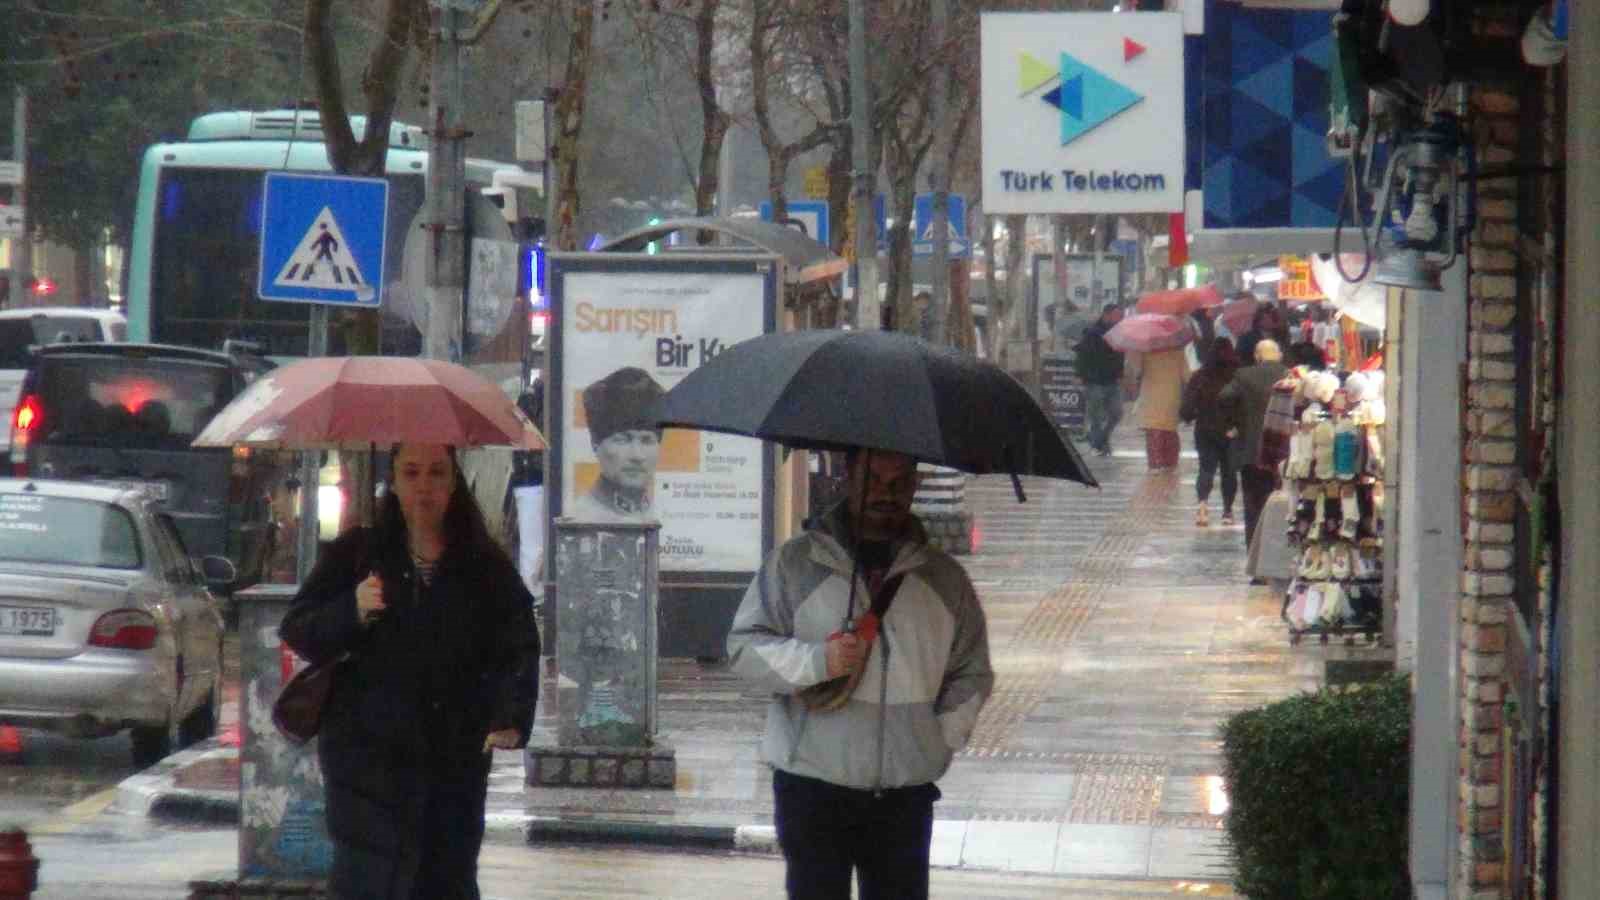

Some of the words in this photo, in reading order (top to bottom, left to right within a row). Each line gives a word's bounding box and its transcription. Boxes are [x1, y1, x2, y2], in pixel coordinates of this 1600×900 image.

[1000, 170, 1054, 192] Türk
[1062, 170, 1166, 192] Telekom
[575, 302, 677, 339] Sarışın
[656, 335, 693, 367] Bir
[12, 610, 51, 629] 1975
